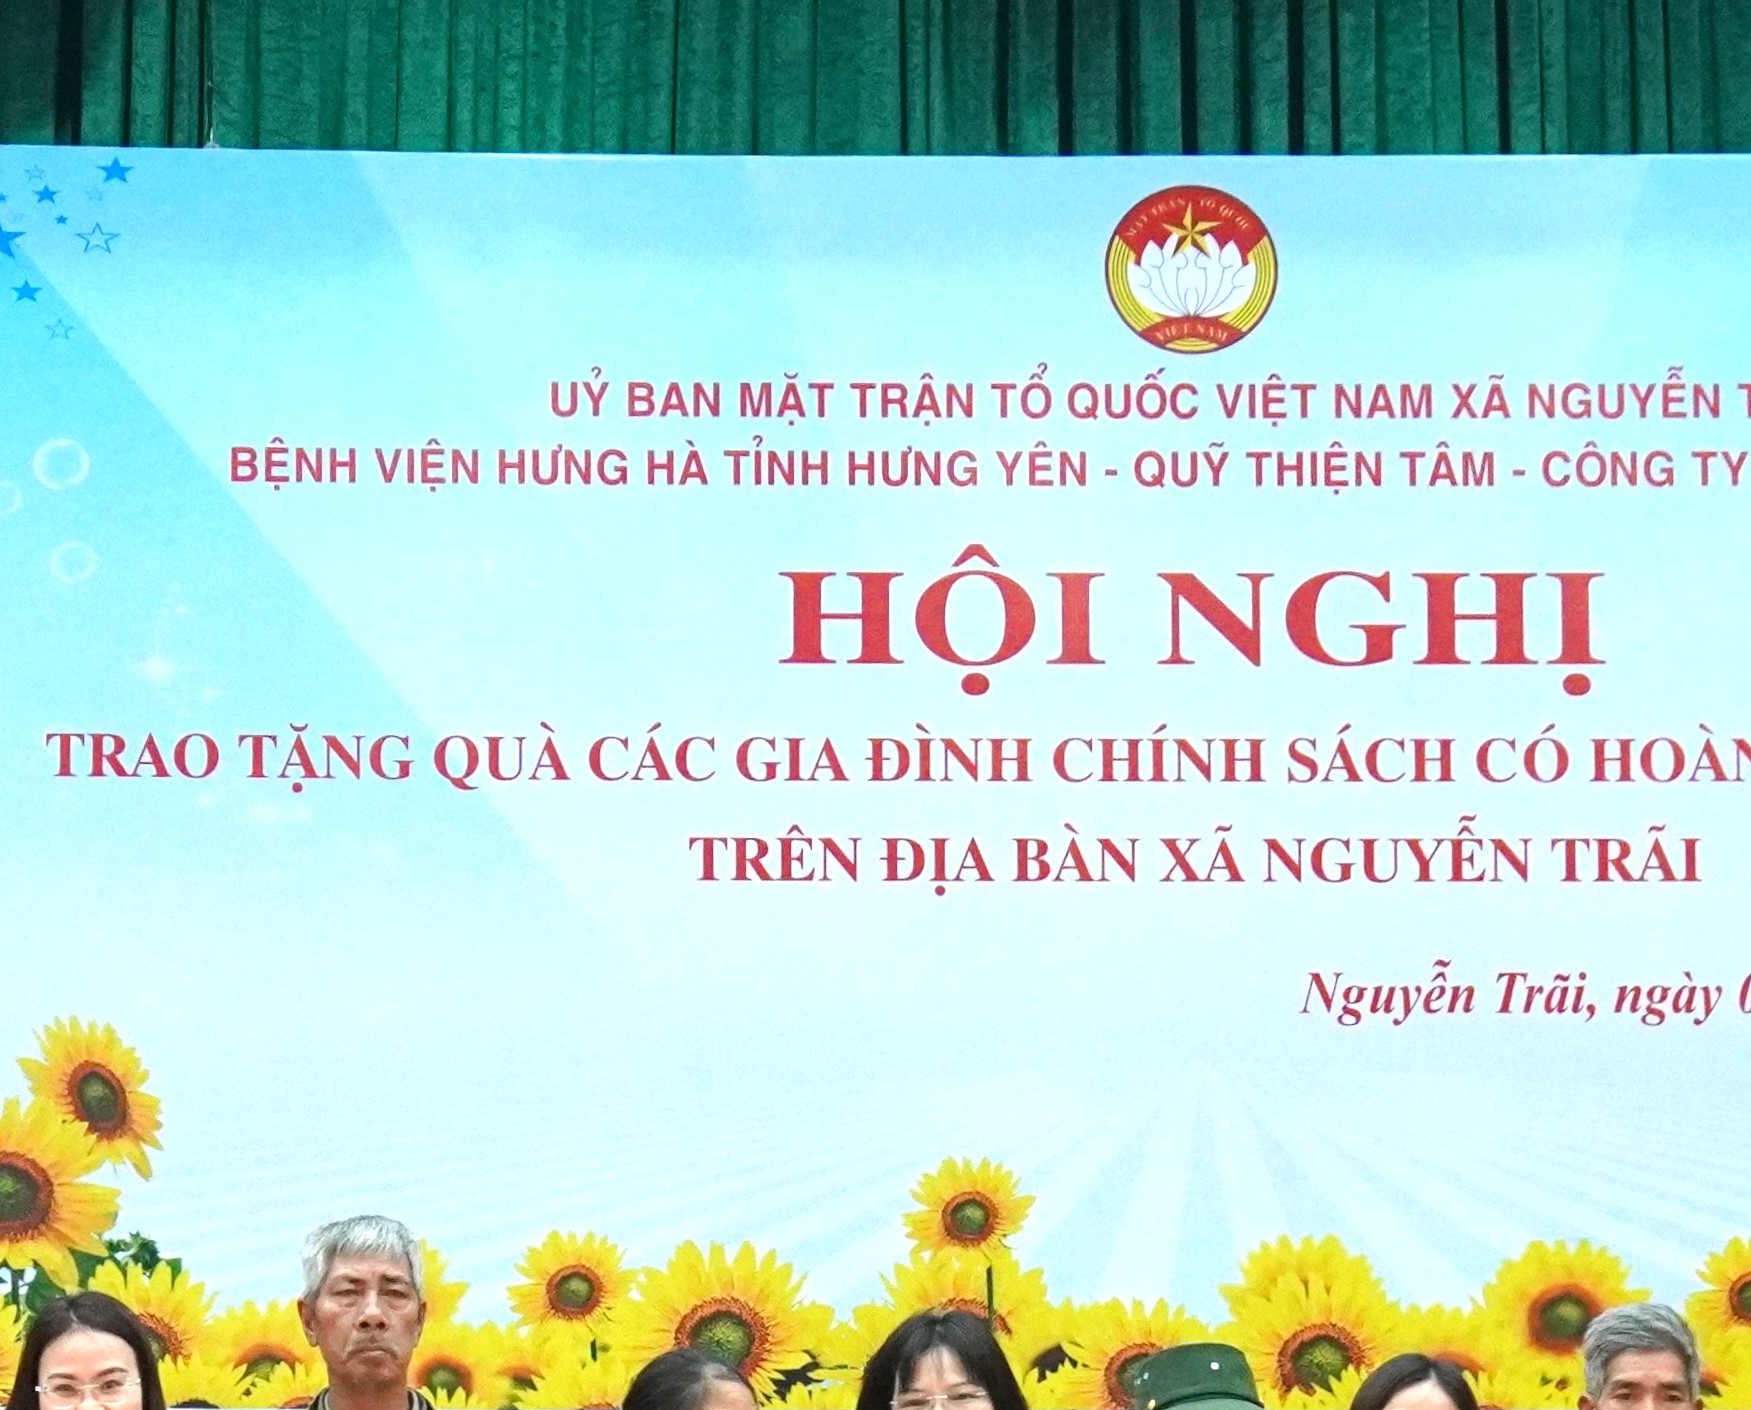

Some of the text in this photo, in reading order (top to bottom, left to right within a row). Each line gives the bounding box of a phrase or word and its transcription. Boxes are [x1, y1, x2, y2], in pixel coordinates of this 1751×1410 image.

[550, 365, 610, 418] UỶ
[627, 381, 721, 418] BAN
[739, 371, 835, 427] MẶT
[849, 372, 974, 427] TRẬN
[990, 361, 1053, 420] TỔ
[1067, 366, 1199, 421] QUỐC
[1215, 372, 1318, 428] VIỆT
[1334, 382, 1433, 420] NAM
[1450, 373, 1512, 420] XÃ
[1527, 365, 1721, 420] NGUYỄN
[230, 436, 357, 492] BỆNH
[374, 437, 479, 493] VIỆN
[498, 443, 628, 487] HƯNG
[646, 439, 709, 486] HÀ
[723, 434, 829, 487] TỈNH
[847, 445, 978, 488] HƯNG
[995, 440, 1087, 487] YÊN
[1133, 441, 1230, 489] QUỸ
[1245, 440, 1383, 495] THIỆN
[1398, 440, 1495, 488] TÂM
[1541, 440, 1675, 488] CÔNG
[1690, 450, 1749, 487] TY
[777, 543, 1607, 697] HỘI NGHỊ
[45, 731, 220, 780] TRAO
[237, 722, 415, 794] TẶNG
[433, 721, 572, 791] QUÀ
[588, 721, 716, 783] CÁC
[735, 736, 851, 783] GIA
[864, 722, 1034, 783] ĐÌNH
[1052, 723, 1267, 784] CHÍNH
[1287, 722, 1457, 784] SÁCH
[1475, 722, 1570, 784] CÓ
[688, 814, 1703, 897] TRÊN ĐỊA BÀN XÃ NGUYỄN TRÃI
[1299, 958, 1476, 1027] Nguyễn
[1495, 971, 1597, 1023] Trãi,
[1613, 970, 1724, 1027] ngày
